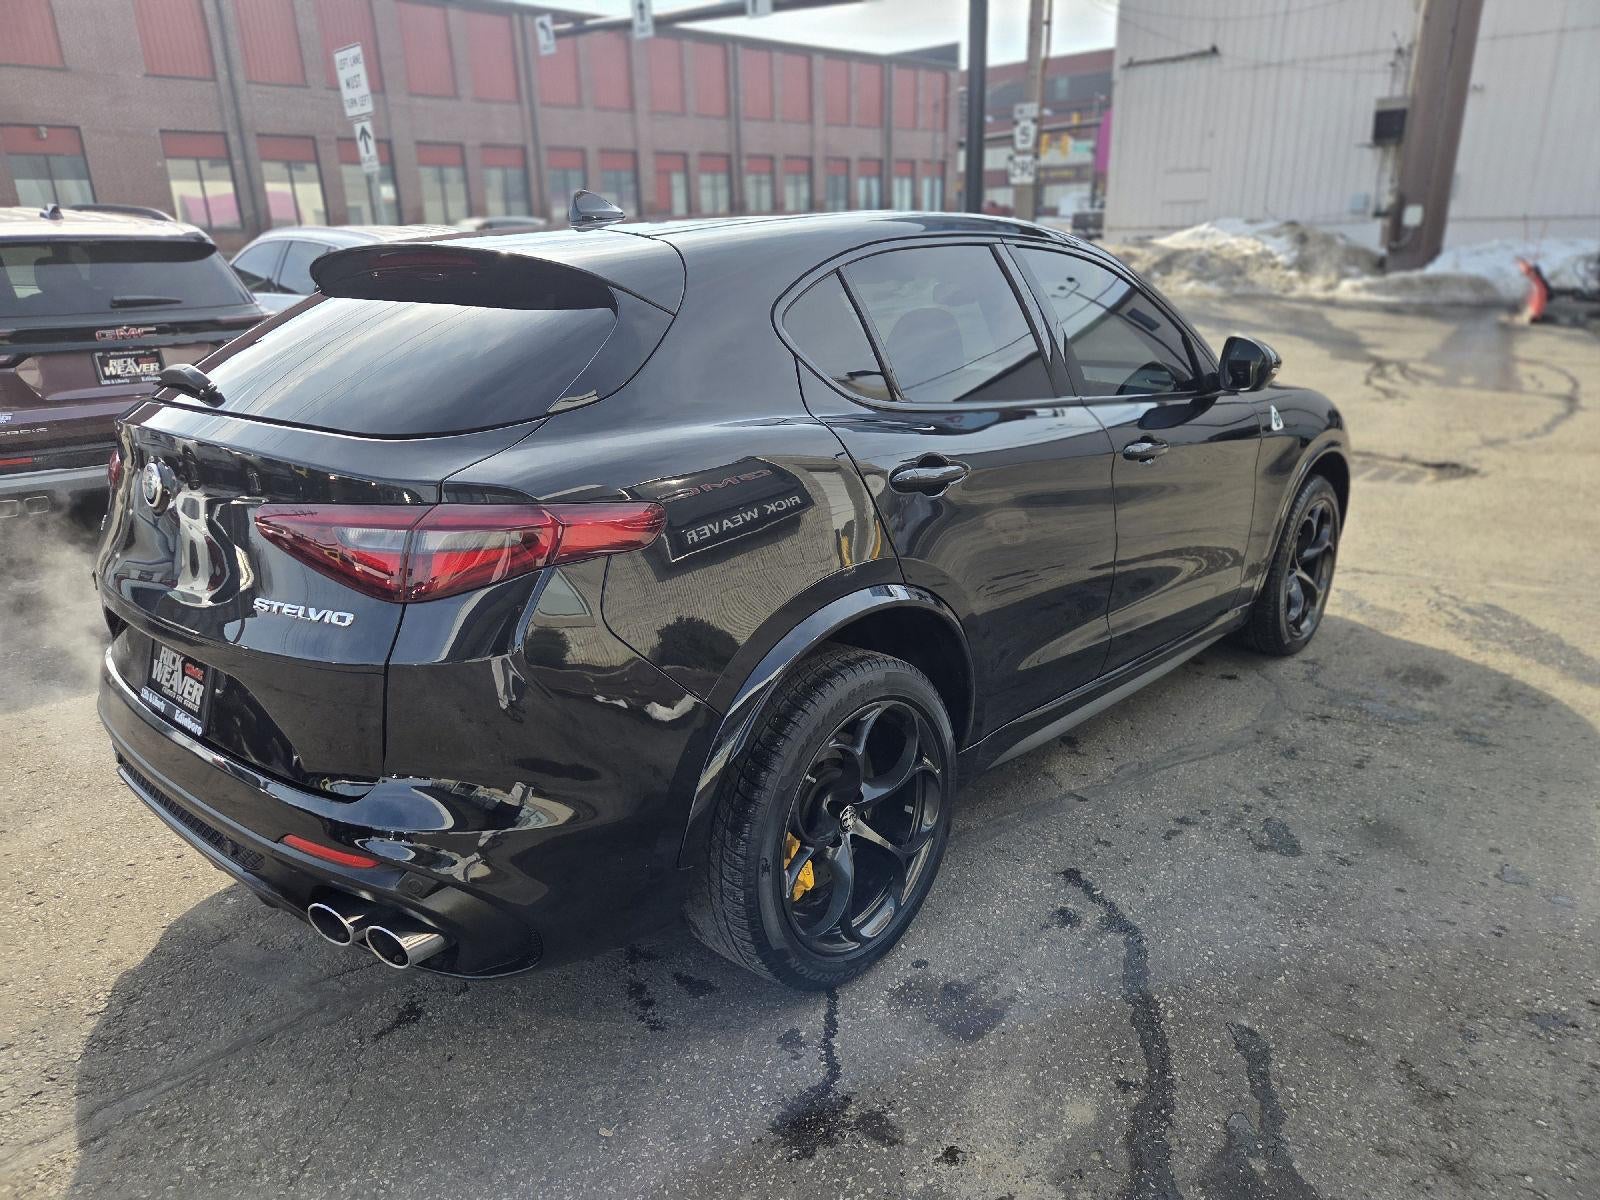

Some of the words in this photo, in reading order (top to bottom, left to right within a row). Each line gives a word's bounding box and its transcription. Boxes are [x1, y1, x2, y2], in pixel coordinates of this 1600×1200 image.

[104, 362, 160, 376] WEAVER
[108, 357, 138, 369] RICK
[253, 597, 355, 627] STELVIO
[160, 646, 185, 671] RICK
[152, 659, 204, 706] WEAVER
